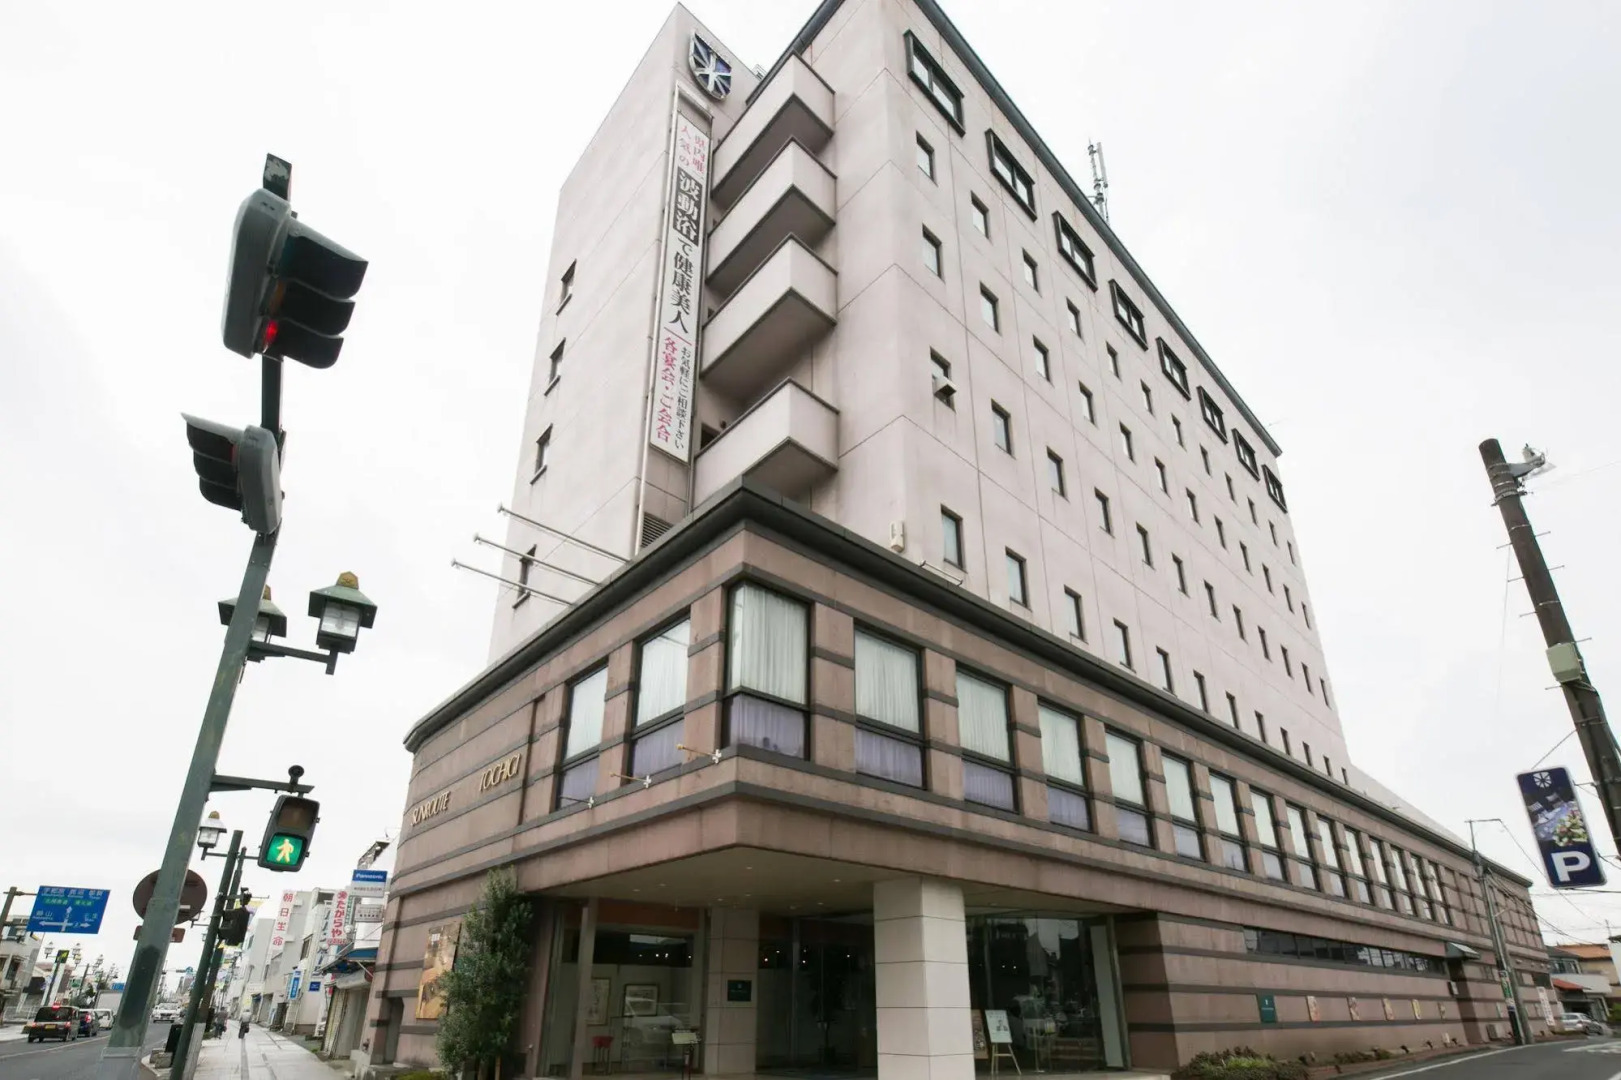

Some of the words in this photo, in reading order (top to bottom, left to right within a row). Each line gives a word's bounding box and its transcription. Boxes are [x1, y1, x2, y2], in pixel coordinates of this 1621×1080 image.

[1551, 850, 1591, 882] P
[273, 893, 293, 946] 朝日生命
